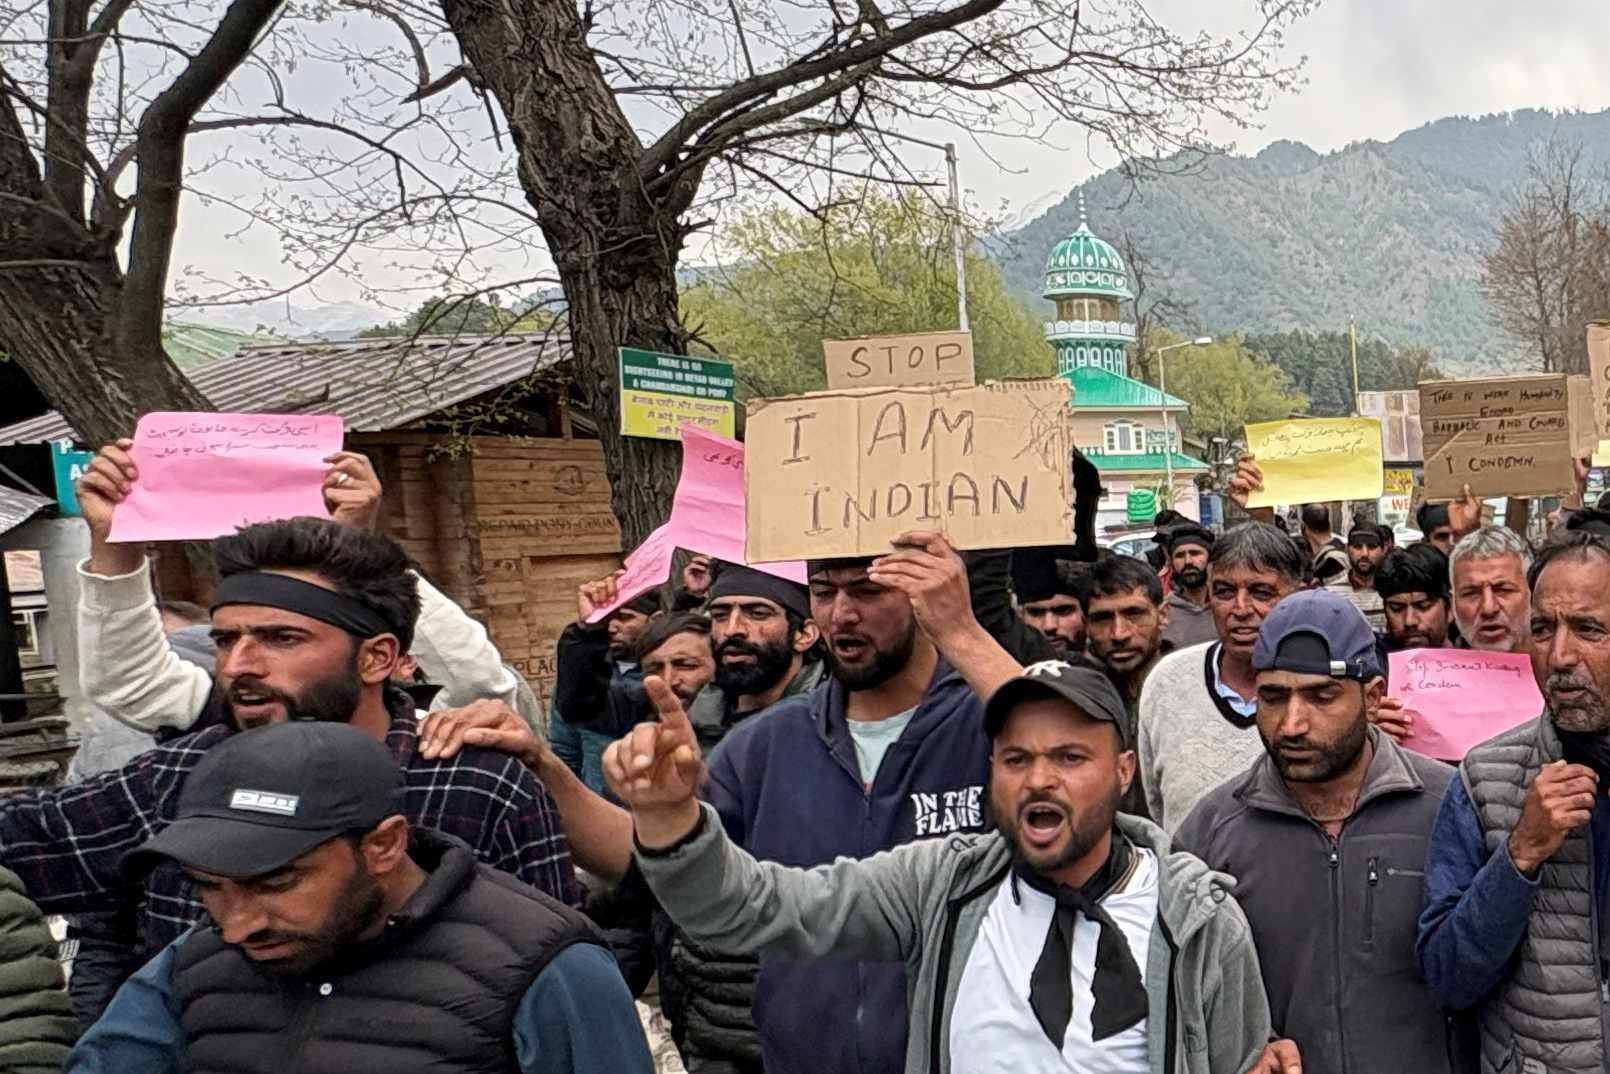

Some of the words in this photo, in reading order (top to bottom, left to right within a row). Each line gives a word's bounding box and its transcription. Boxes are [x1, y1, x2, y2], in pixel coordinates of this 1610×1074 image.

[847, 343, 962, 378] STOP
[782, 407, 817, 465] I
[867, 401, 974, 456] AM
[804, 472, 1028, 536] INDIAN
[911, 793, 938, 819] IN
[943, 786, 983, 810] THE
